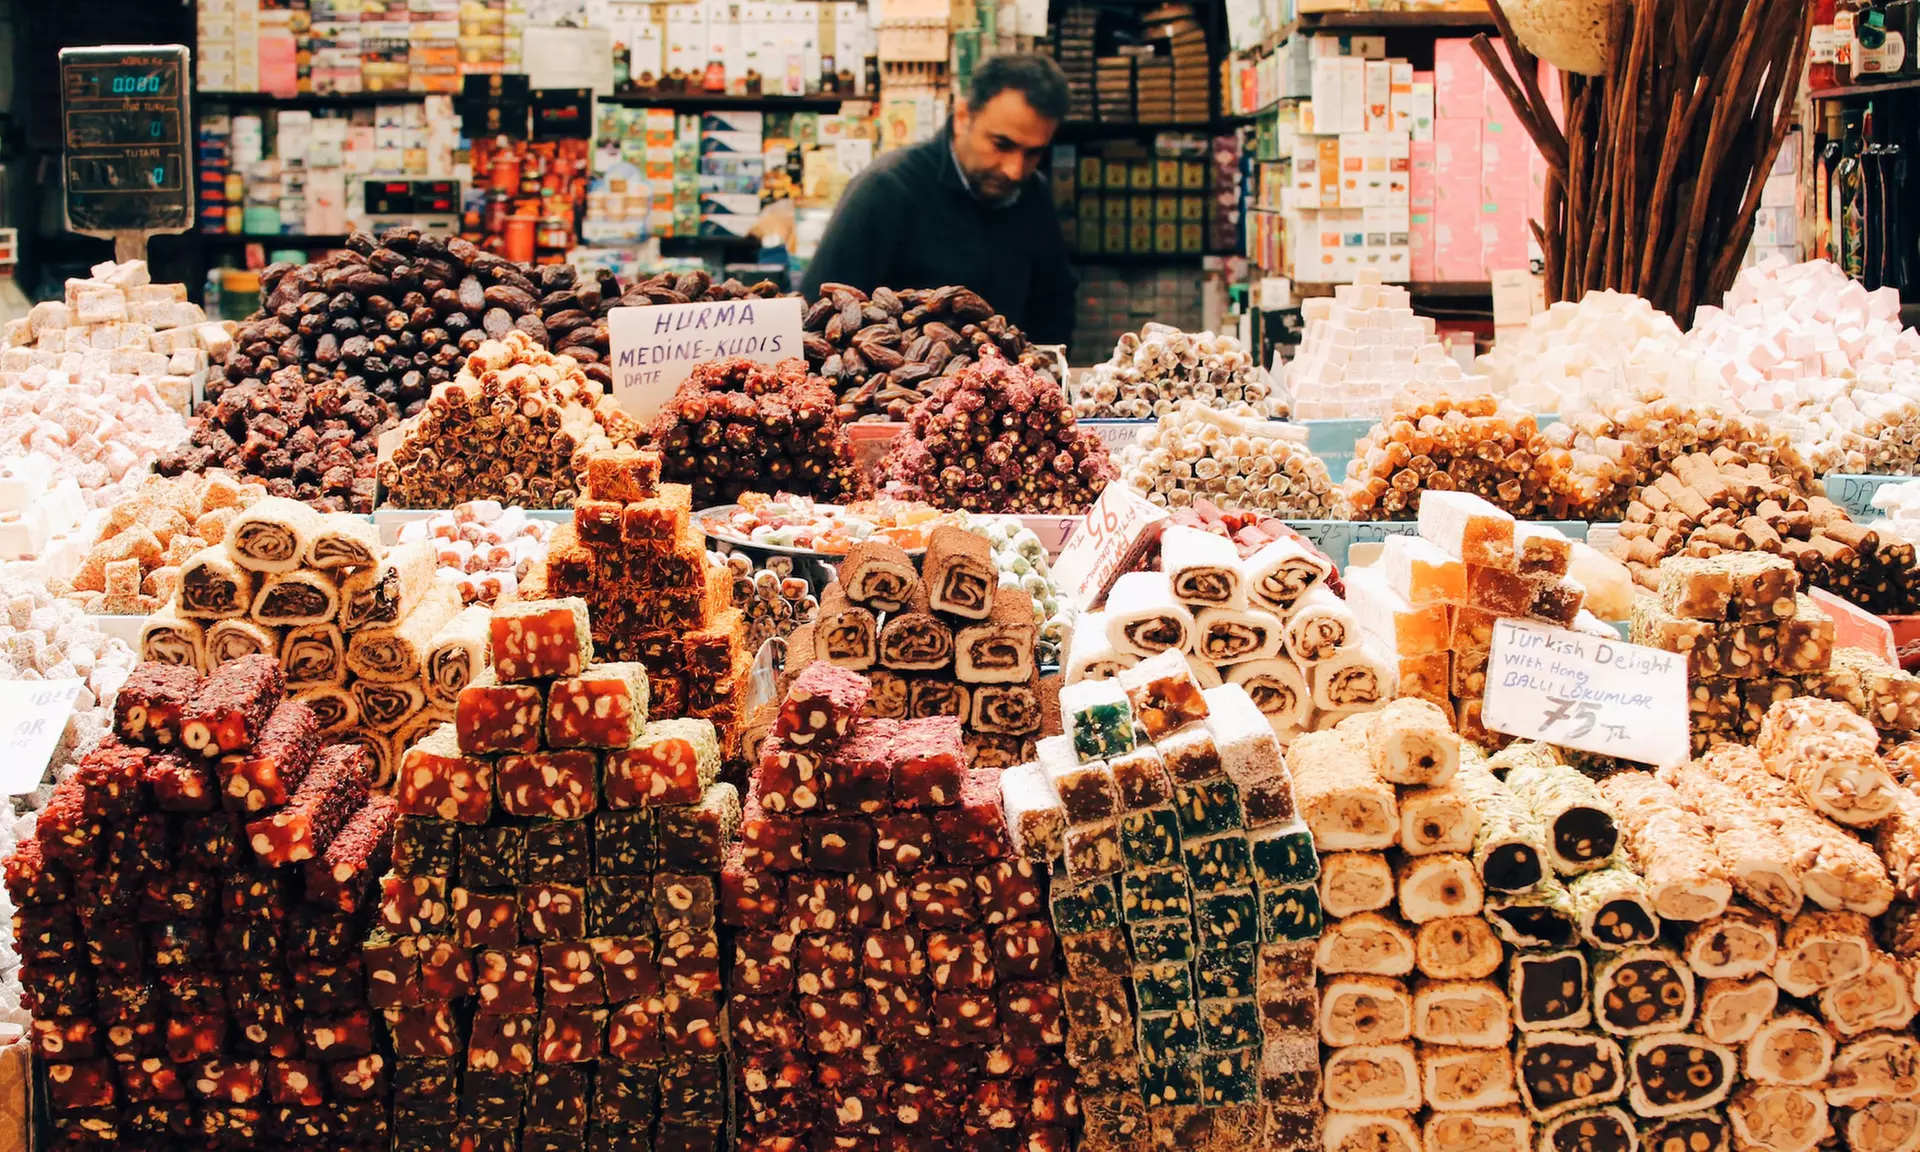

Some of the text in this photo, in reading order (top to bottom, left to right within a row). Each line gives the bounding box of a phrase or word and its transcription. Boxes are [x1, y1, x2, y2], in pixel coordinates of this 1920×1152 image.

[150, 121, 161, 137] 0
[153, 167, 163, 183] 0
[654, 303, 755, 335] HURMA
[624, 370, 661, 388] DATE
[1086, 491, 1118, 550] 95
[1501, 623, 1673, 675] Turkish Delight
[1503, 671, 1554, 692] BALLI
[1550, 661, 1590, 685] Honey
[1538, 695, 1603, 740] 75
